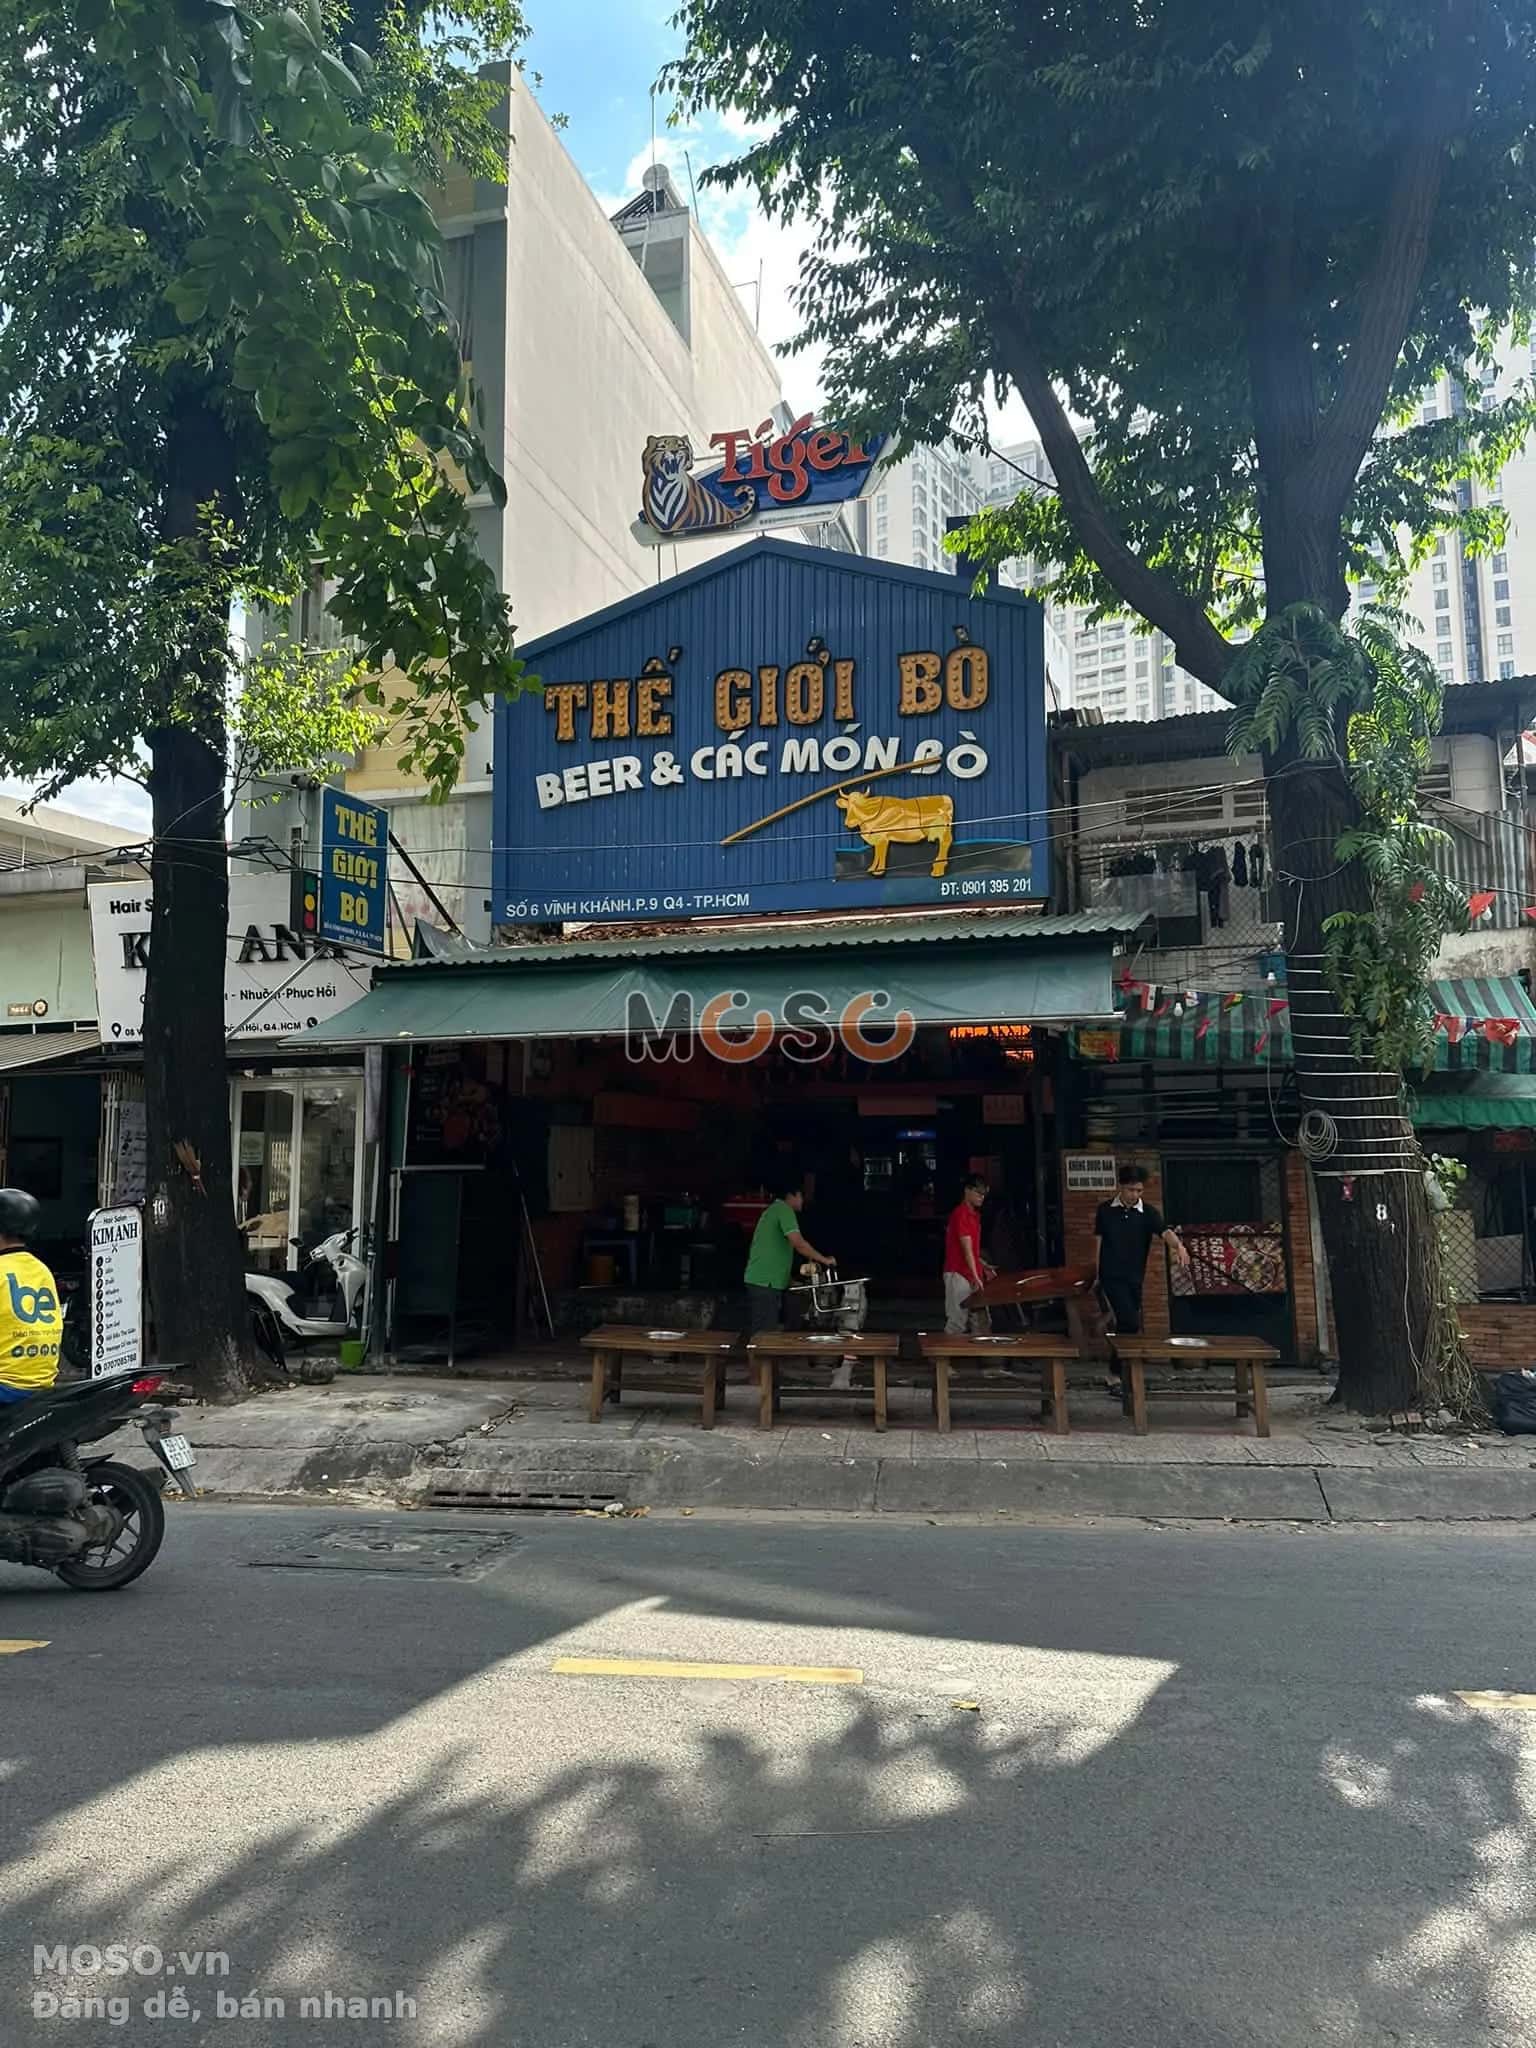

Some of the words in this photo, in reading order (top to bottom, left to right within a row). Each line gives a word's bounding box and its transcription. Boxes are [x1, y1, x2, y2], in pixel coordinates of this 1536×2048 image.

[544, 646, 682, 743] THẾ
[714, 636, 855, 733] GIỚI
[898, 625, 989, 717] BÒ
[536, 755, 644, 809] BEER
[650, 751, 684, 786] &
[691, 729, 769, 780] CÁC
[780, 723, 900, 773] MÓN
[911, 730, 988, 779] BÒ
[335, 804, 379, 848] THẾ
[941, 882, 960, 896] ĐT:
[962, 880, 987, 895] 0901
[989, 879, 1009, 894] 395
[1013, 878, 1032, 892] 201
[110, 899, 142, 914] Hair
[340, 890, 369, 926] BÒ
[506, 899, 528, 918] SỐ
[530, 903, 538, 916] 6
[544, 899, 577, 916] VĨNH
[1376, 1203, 1388, 1221] 8
[93, 1227, 114, 1246] KIM
[114, 1222, 138, 1241] ANH
[6, 1272, 57, 1325] be
